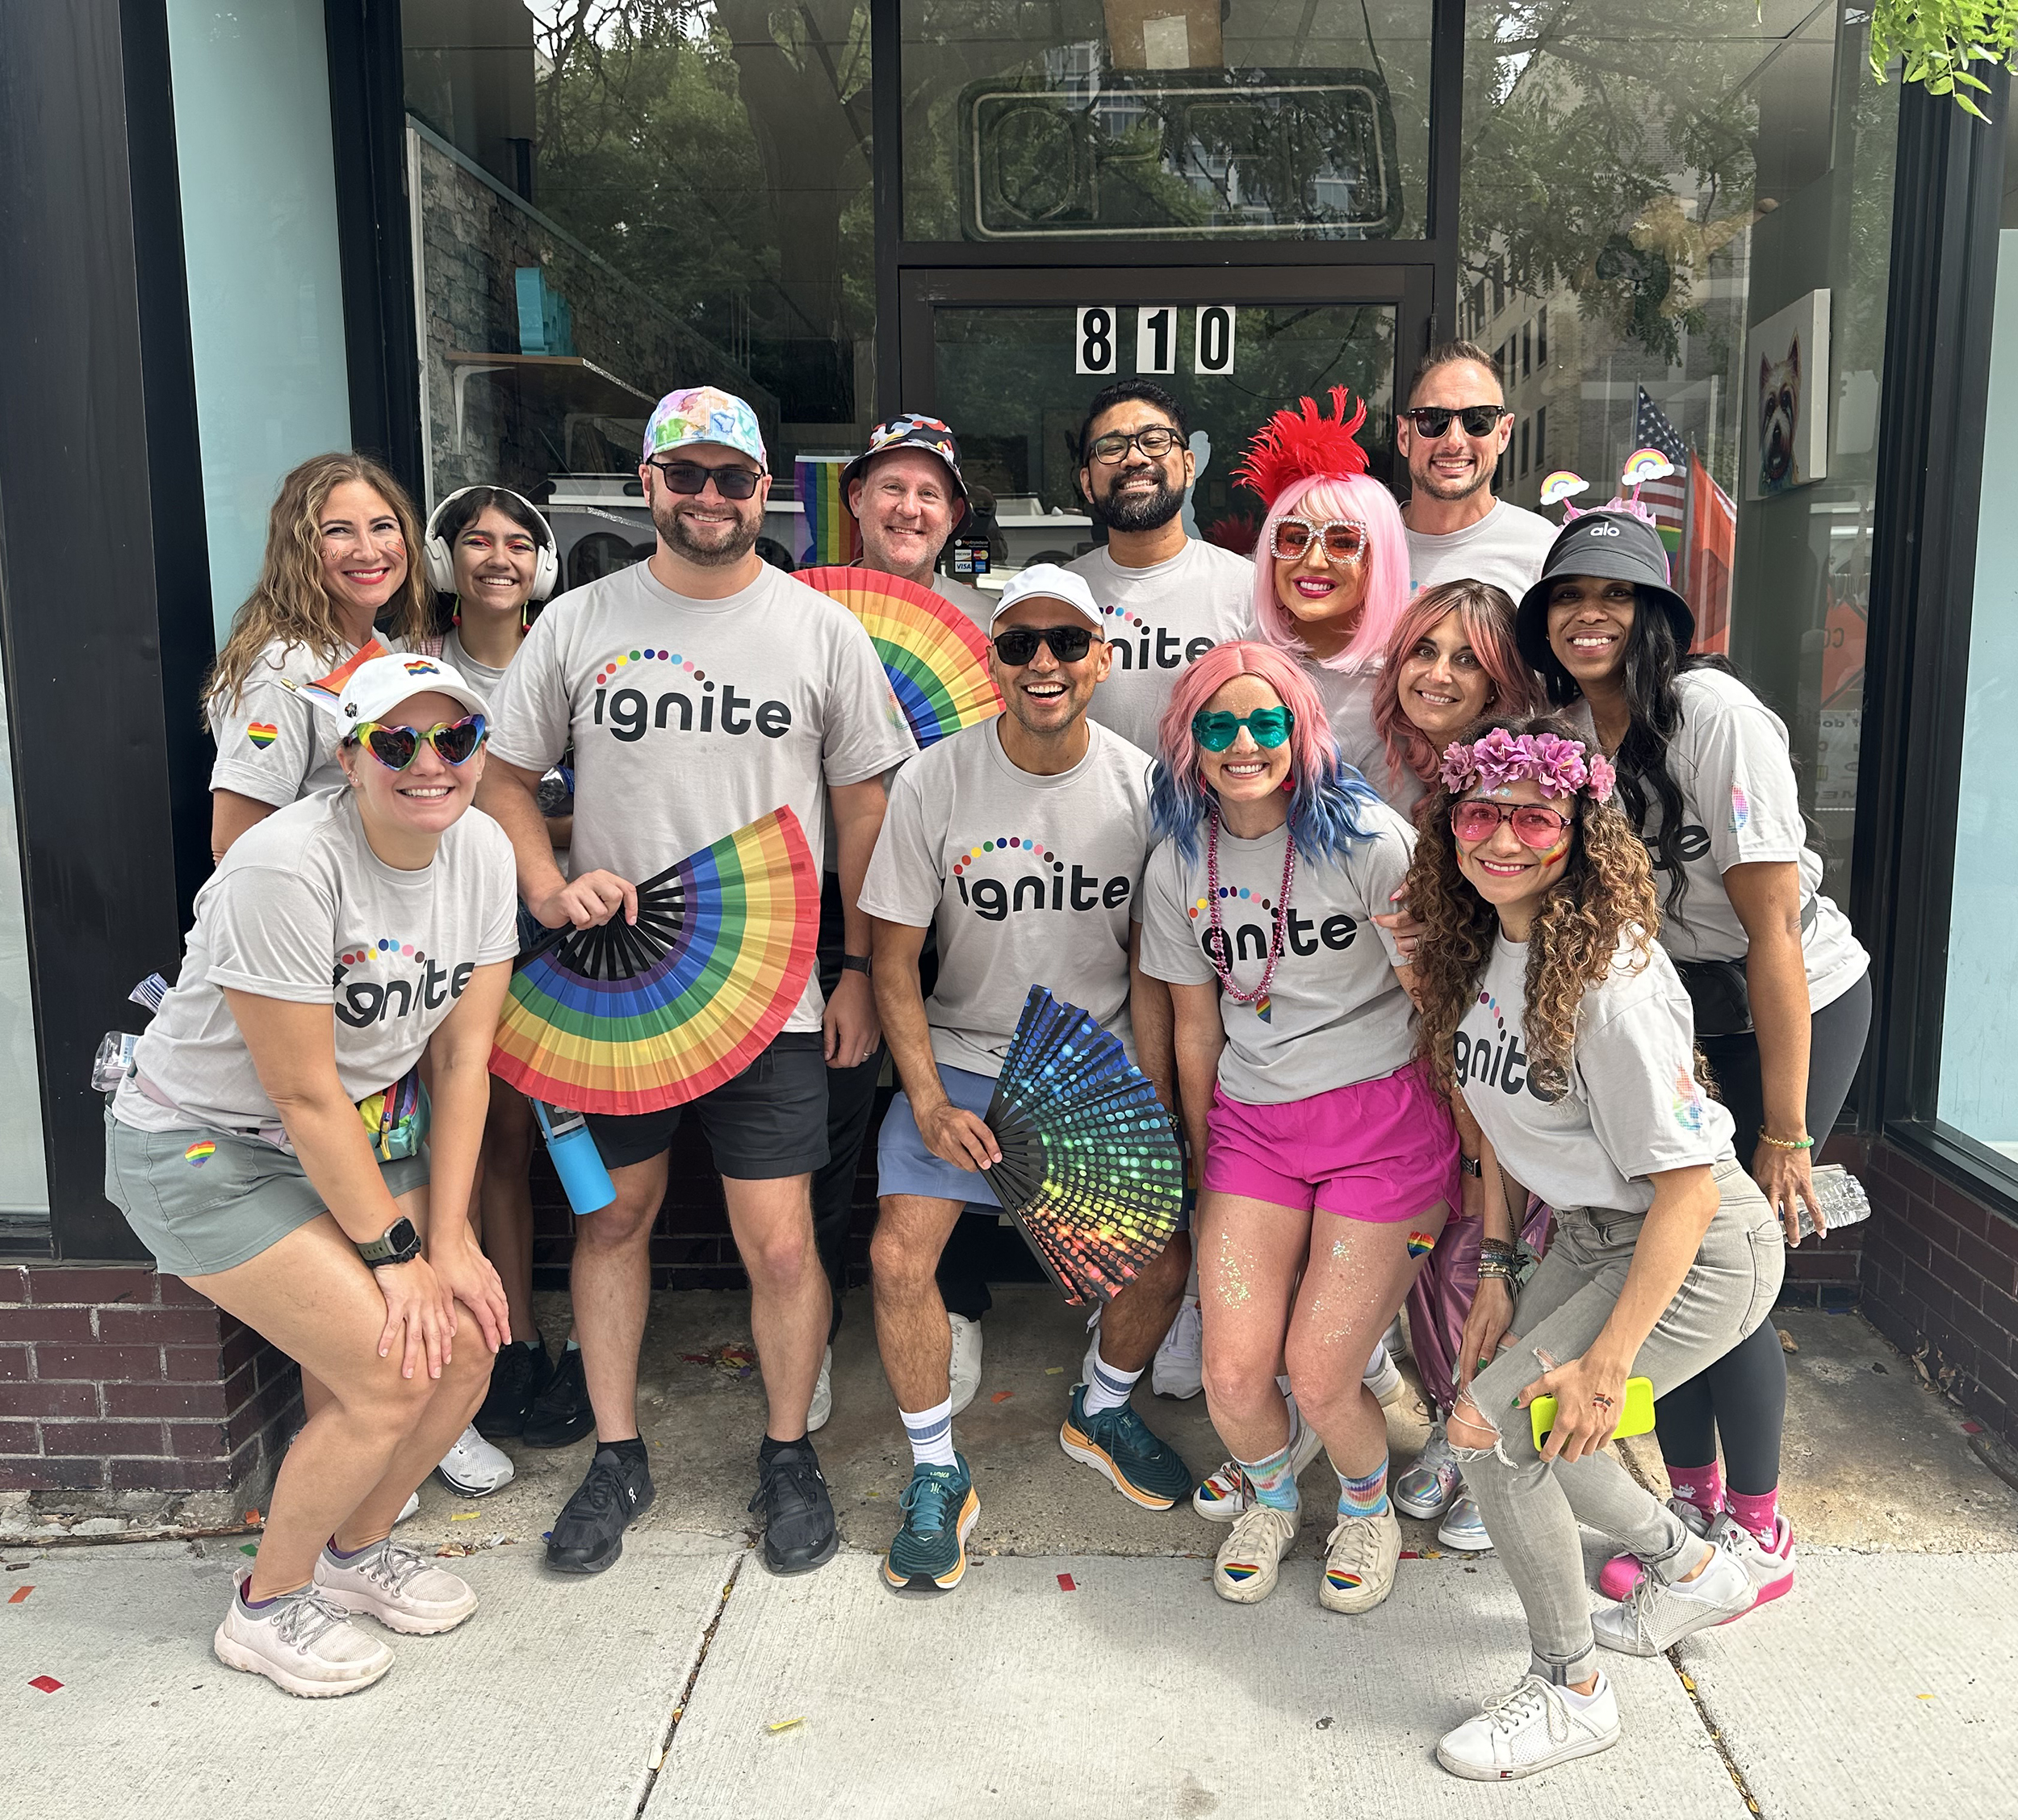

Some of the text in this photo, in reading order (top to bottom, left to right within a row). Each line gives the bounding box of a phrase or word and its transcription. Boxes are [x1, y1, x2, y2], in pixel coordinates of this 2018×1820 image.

[320, 548, 350, 561] OVE
[1590, 522, 1620, 537] alo
[1107, 625, 1216, 670] nite
[593, 675, 792, 743] ignite
[953, 862, 1130, 922] ignite
[1201, 907, 1358, 975] gnite
[1454, 1029, 1569, 1102] gnite
